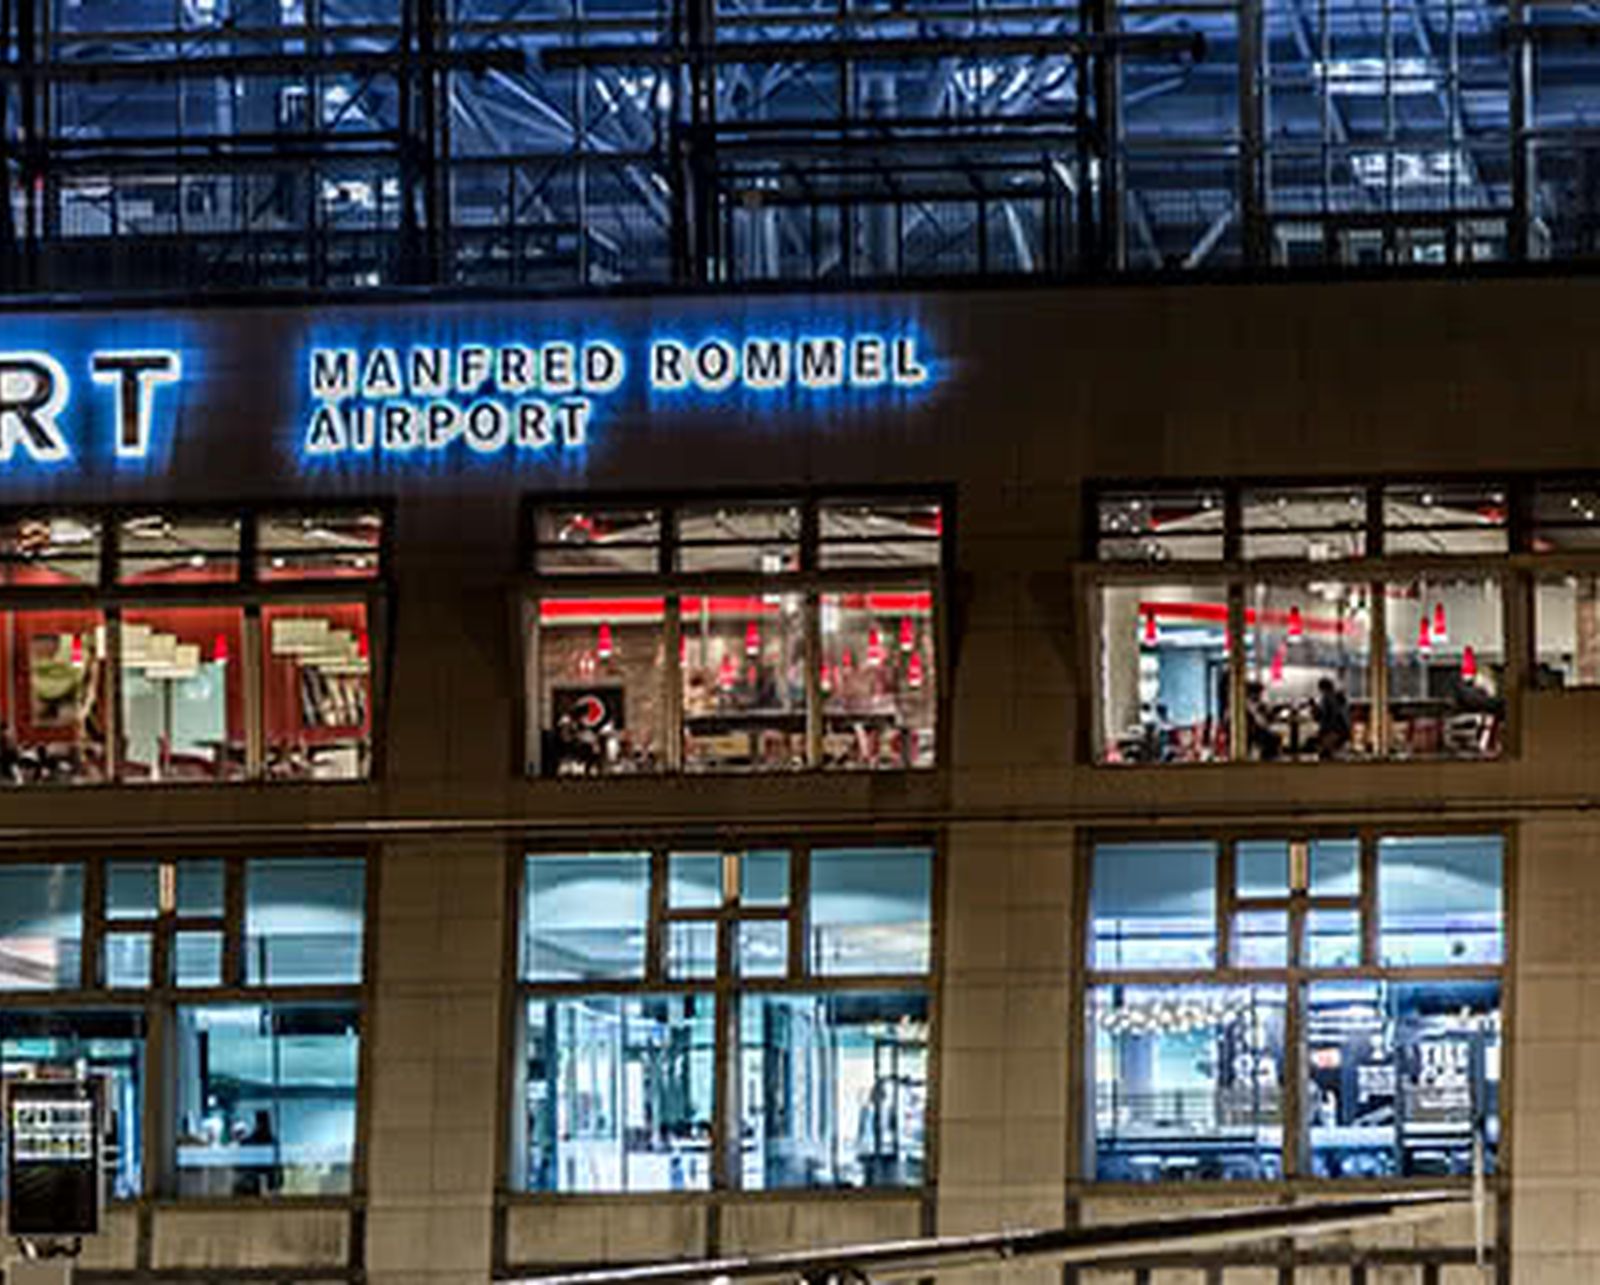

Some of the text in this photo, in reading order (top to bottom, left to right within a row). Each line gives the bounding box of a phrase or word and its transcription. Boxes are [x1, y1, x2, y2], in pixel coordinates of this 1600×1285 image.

[310, 338, 928, 394] MANFRED ROMMEL
[306, 400, 591, 450] AIRPORT
